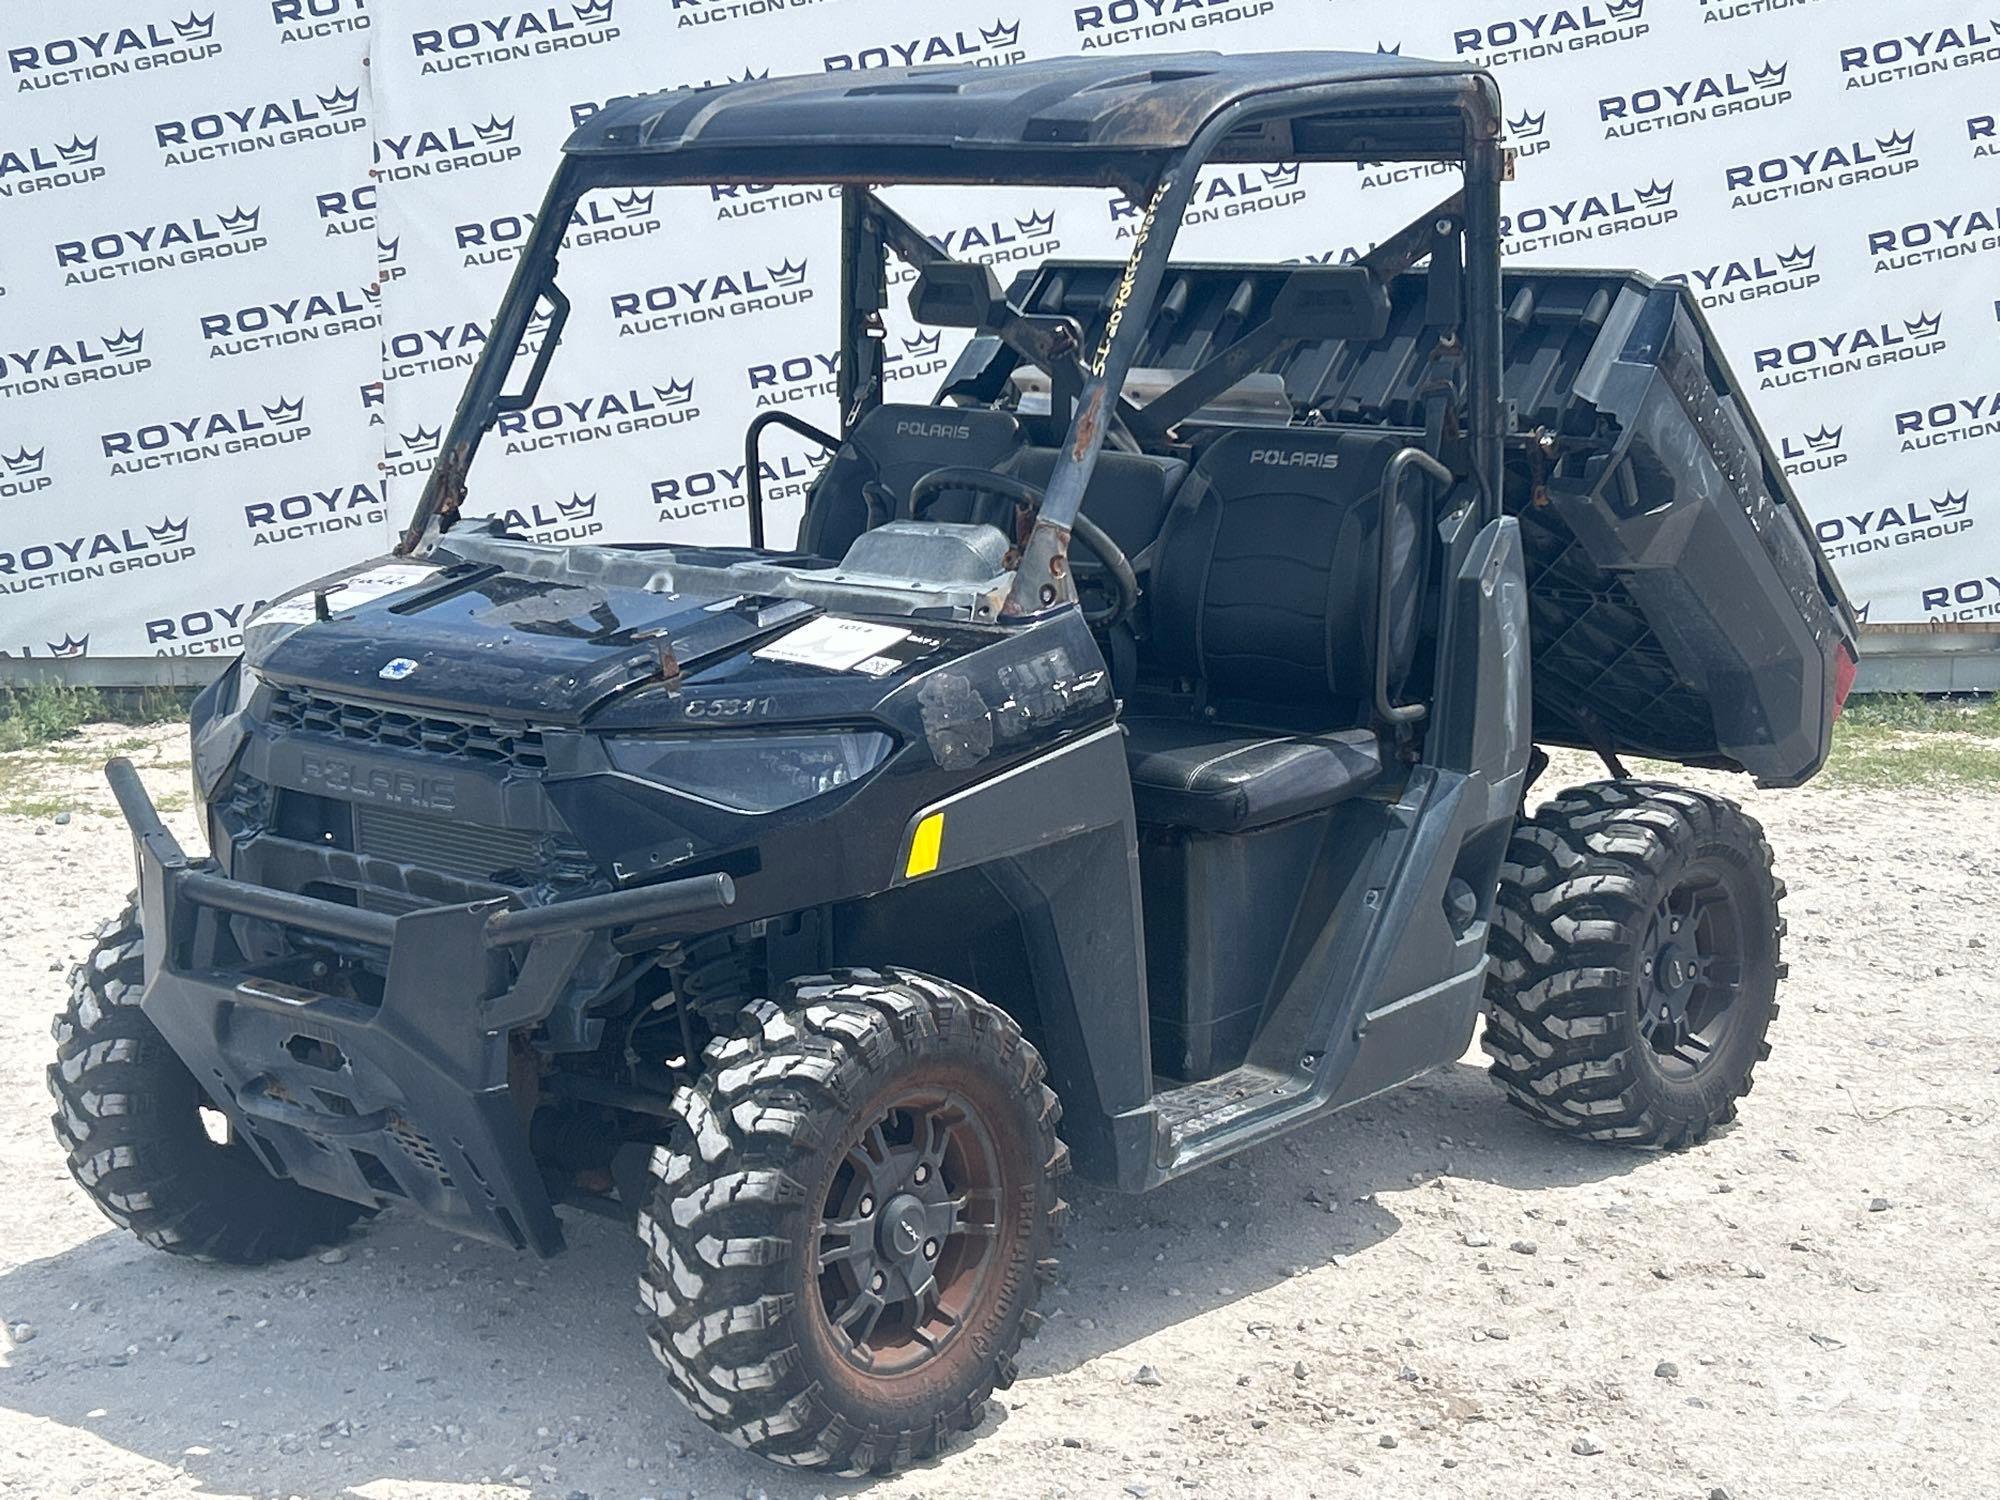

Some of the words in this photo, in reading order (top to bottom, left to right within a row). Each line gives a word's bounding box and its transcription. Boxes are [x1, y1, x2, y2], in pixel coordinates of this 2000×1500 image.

[281, 16, 370, 44] AUCTIO
[413, 8, 574, 56] ROYAL
[1082, 19, 1186, 50] AUCTION
[1192, 2, 1273, 28] GROUP
[1454, 6, 1606, 54] ROYAL
[1474, 41, 1563, 68] UCTION
[1569, 24, 1649, 50] GROUP
[1840, 24, 1991, 72] ROYAL
[8, 25, 174, 73] ROYAL
[18, 61, 129, 92] AUCTION
[135, 44, 222, 70] GROUP
[421, 44, 529, 75] AUCTION
[535, 28, 620, 54] GROUP
[977, 51, 1025, 68] OUP
[1846, 59, 1947, 90] AUCTION
[1953, 48, 2000, 67] GRO
[1599, 74, 1749, 121] ROYAL
[1605, 108, 1706, 139] AUCTION
[1712, 91, 1791, 117] GROUP
[155, 99, 319, 147] ROYAL
[165, 135, 274, 167] AUCTION
[280, 118, 366, 144] GROUP
[374, 127, 475, 163] YAL
[18, 167, 105, 194] GROUP
[376, 164, 430, 183] TION
[436, 147, 521, 173] GROUP
[1726, 142, 1875, 191] ROYAL
[1732, 177, 1833, 208] AUCTION
[1839, 160, 1918, 186] GROUP
[717, 189, 822, 220] AUCTION
[1225, 191, 1305, 216] GROUP
[1597, 210, 1677, 236] GROUP
[55, 219, 220, 267] ROYAL
[577, 221, 660, 246] GROUP
[979, 240, 1060, 265] GROUP
[65, 255, 175, 286] AUCTION
[181, 238, 267, 263] GROUP
[1875, 241, 1976, 273] AUCTION
[611, 271, 768, 318] ROYAL
[1740, 274, 1820, 300] GROUP
[200, 291, 363, 339] ROYAL
[620, 306, 724, 336] AUCTION
[730, 290, 813, 315] GROUP
[210, 327, 319, 358] AUCTION
[324, 315, 382, 336] GRO
[383, 321, 487, 362] OYA
[1754, 324, 1904, 372] ROYAL
[0, 341, 103, 379] YAL
[0, 376, 59, 397] TION
[64, 359, 151, 385] GROUP
[383, 353, 474, 380] UCTION
[1760, 359, 1861, 390] AUCTION
[1867, 341, 1945, 367] GROUP
[756, 381, 837, 408] AUCTIO
[884, 360, 947, 382] ROUP
[101, 409, 264, 457] ROYAL
[498, 390, 655, 437] ROYAL
[506, 425, 611, 455] AUCTION
[617, 407, 700, 433] GROUP
[896, 421, 971, 440] POLARIS
[111, 444, 220, 476] AUCTION
[225, 427, 311, 453] GROUP
[1901, 421, 2000, 452] AUCTION
[651, 457, 806, 503] ROYAL
[1249, 449, 1339, 469] POLARIS
[1784, 454, 1848, 476] ROUP
[0, 477, 52, 497] OUP
[245, 479, 386, 527] ROYA
[659, 495, 745, 522] AUCTIO
[254, 514, 362, 546] AUCTION
[1816, 503, 1931, 542] OYAL
[1823, 537, 1889, 560] CTION
[1895, 519, 1973, 545] GROUP
[109, 547, 195, 573] GROUP
[146, 600, 266, 644] ROY
[155, 634, 243, 656] AUCTIO
[301, 752, 456, 812] POLARIS
